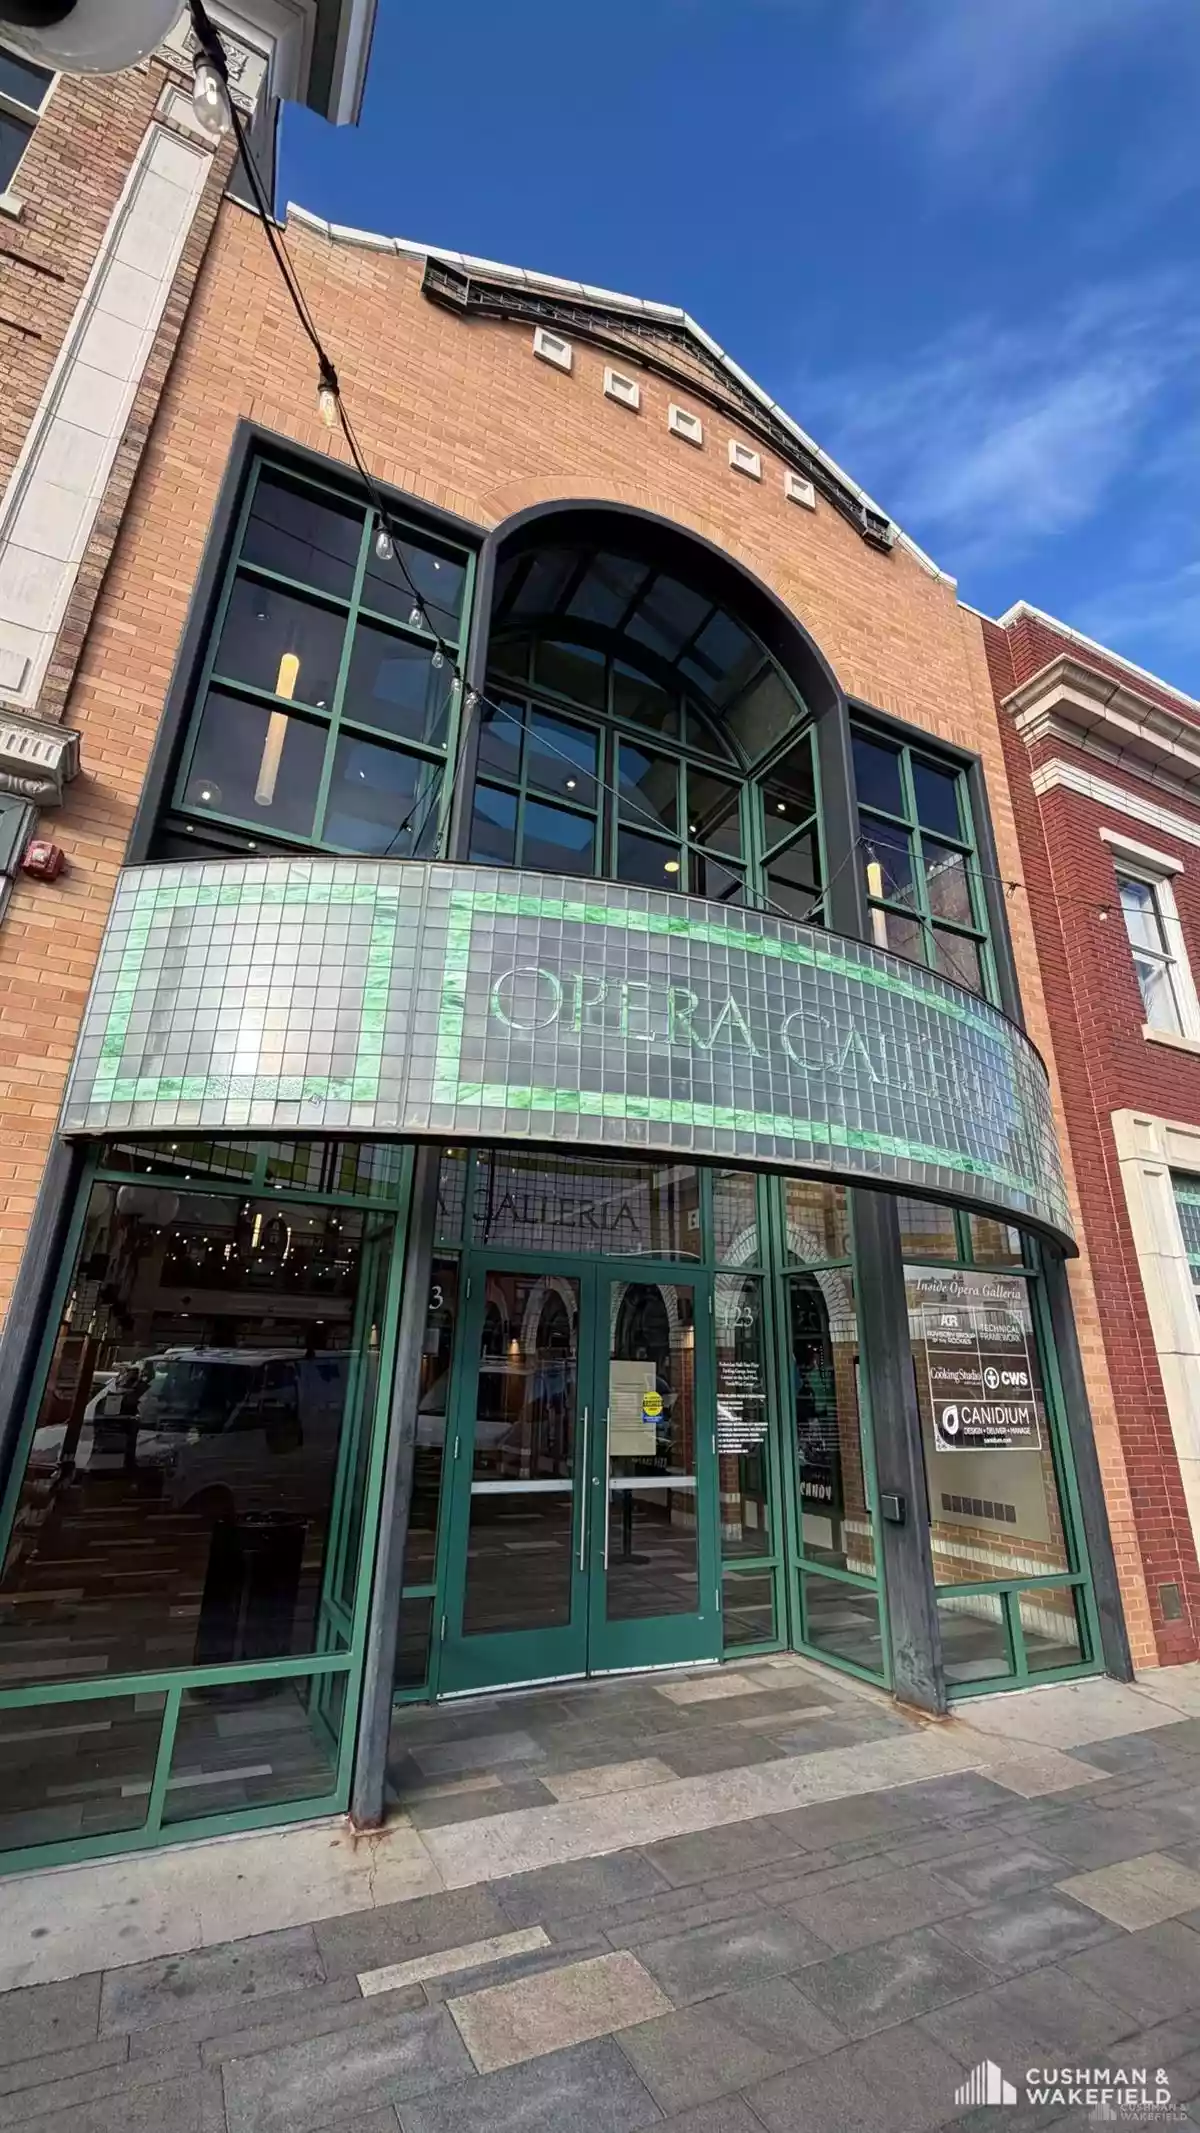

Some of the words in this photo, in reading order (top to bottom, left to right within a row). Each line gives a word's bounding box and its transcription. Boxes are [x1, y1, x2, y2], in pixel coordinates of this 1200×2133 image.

[490, 966, 764, 1058] OPERA
[916, 1278, 947, 1293] Inside
[949, 1281, 979, 1298] Opera
[982, 1284, 1022, 1300] Galleria
[723, 1306, 754, 1328] 123
[980, 1324, 1019, 1334] TECHNICAL
[1001, 1370, 1028, 1386] CWS
[961, 1406, 1030, 1424] CANIDIUM
